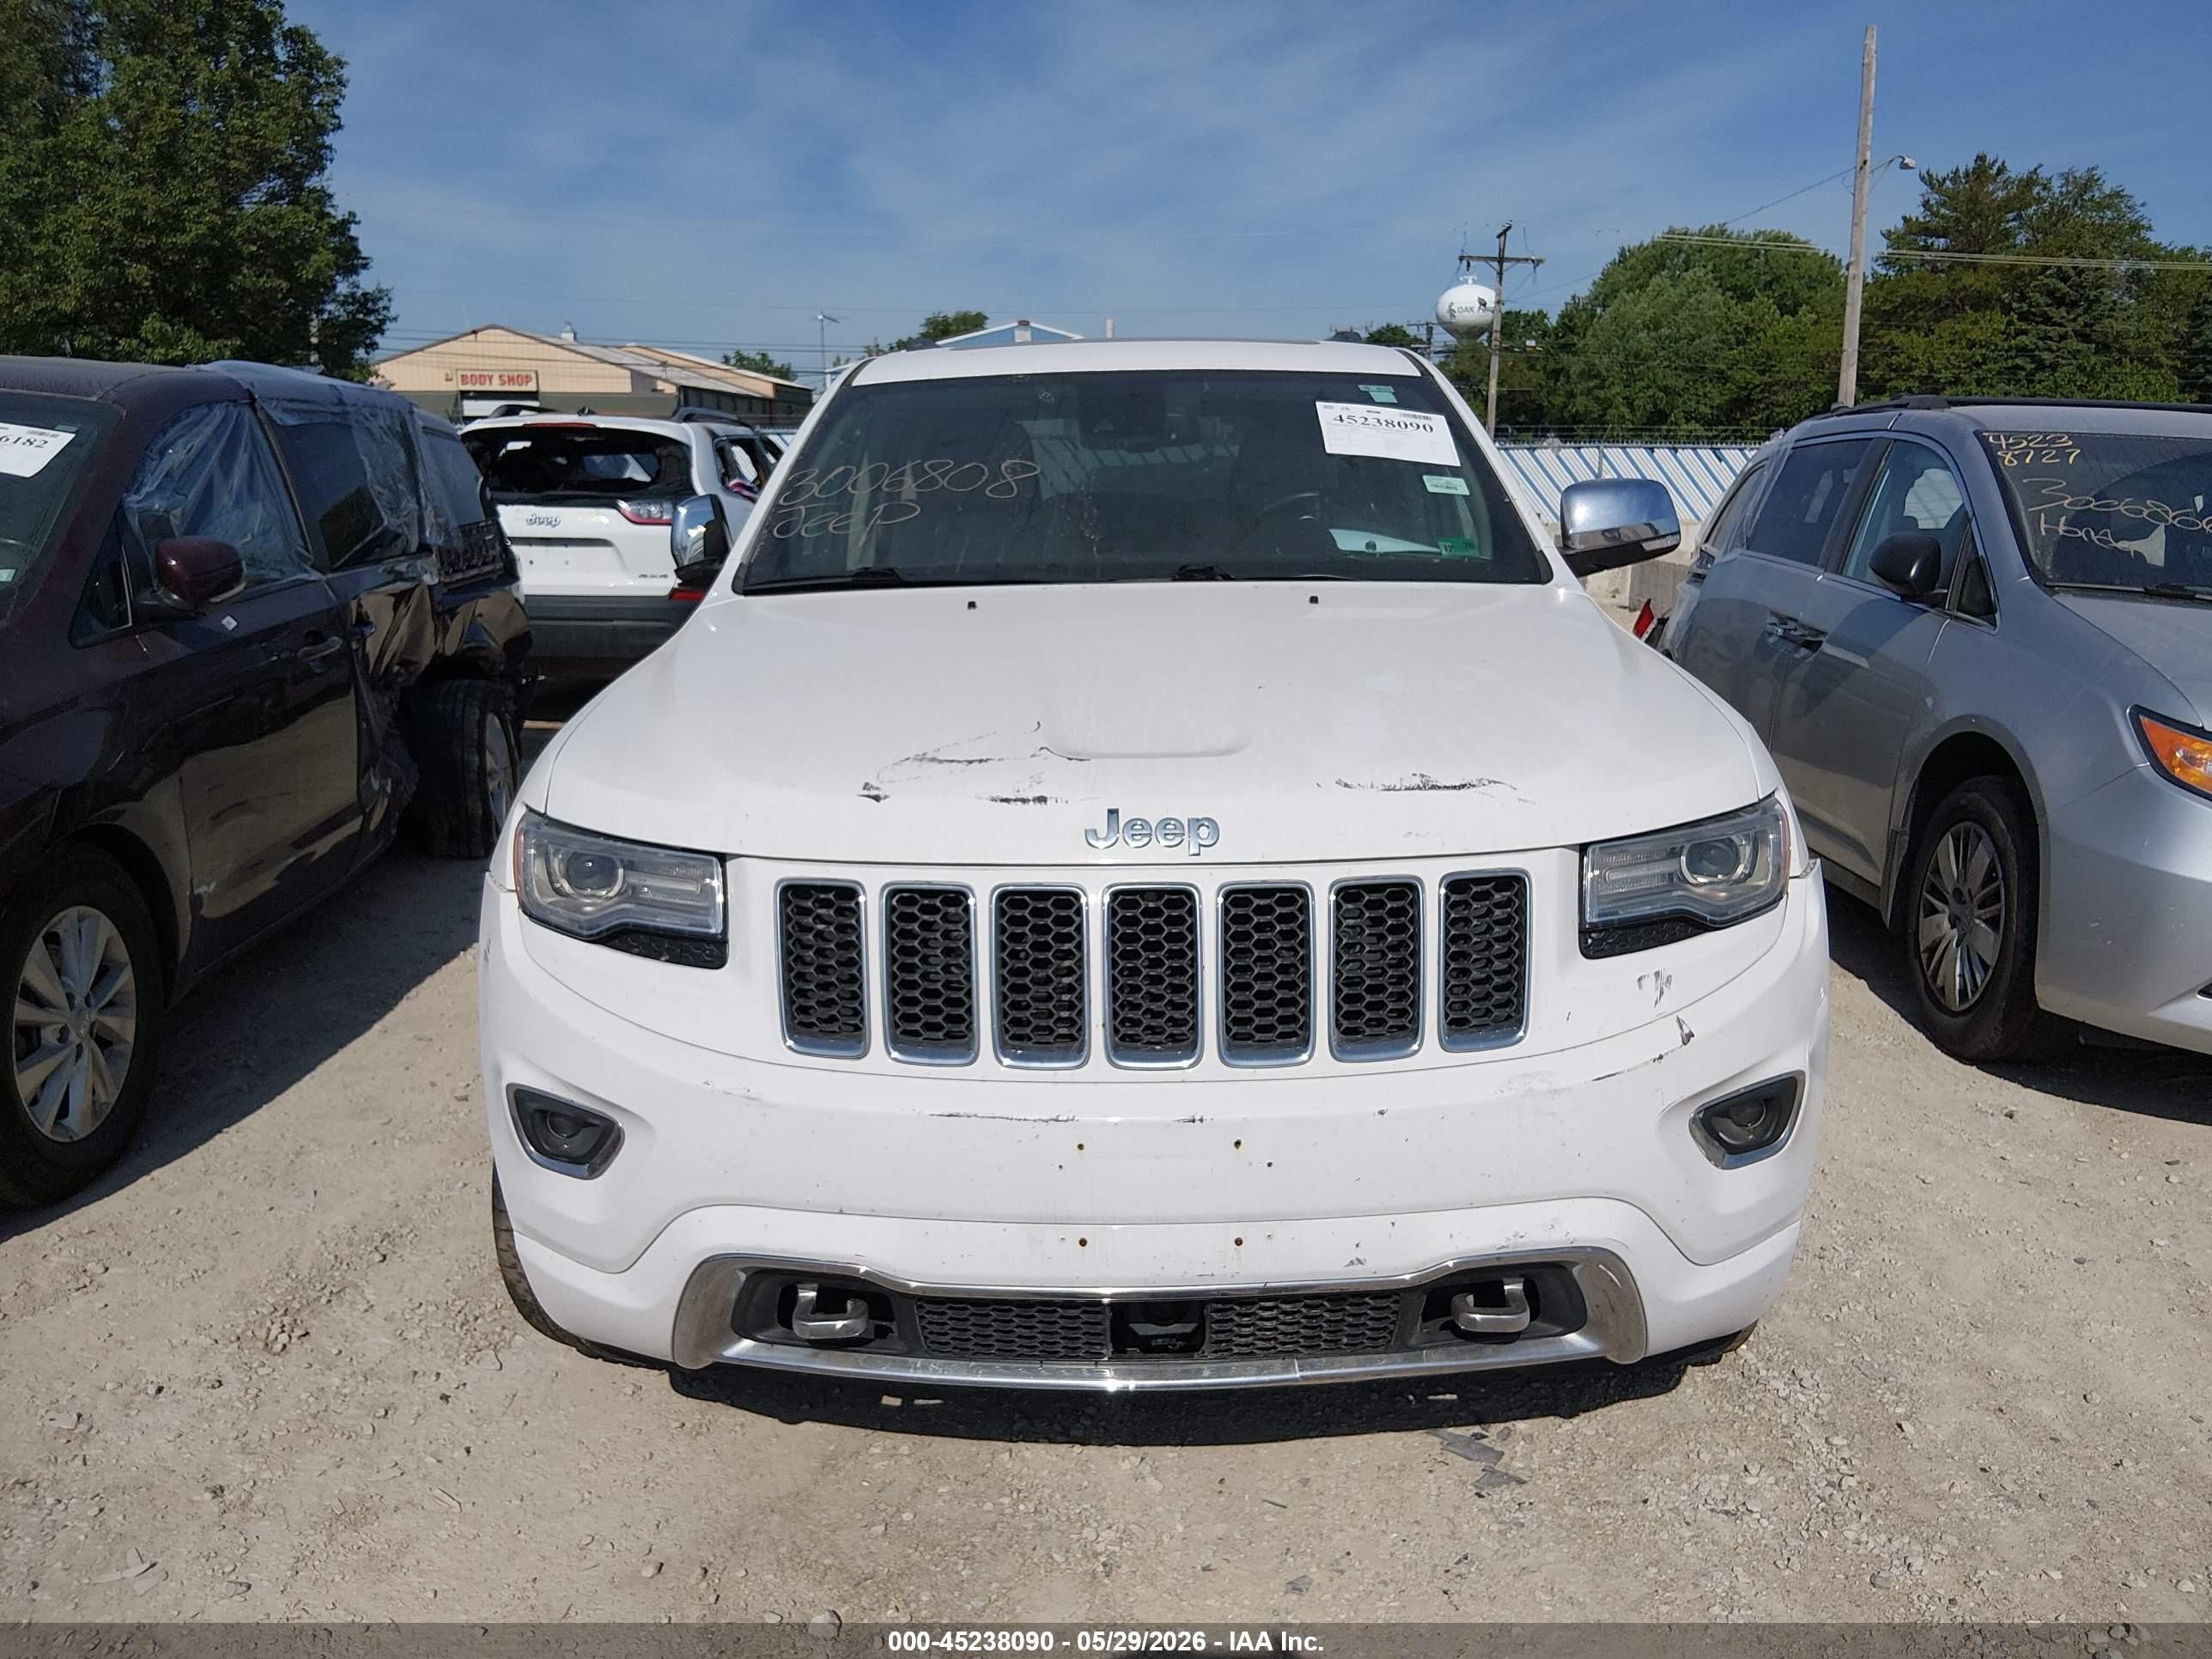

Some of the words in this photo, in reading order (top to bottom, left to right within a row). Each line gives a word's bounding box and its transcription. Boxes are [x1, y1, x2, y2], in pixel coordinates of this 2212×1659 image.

[1457, 306, 1475, 314] OAK
[460, 374, 494, 386] BODY
[498, 374, 532, 386] SHOP
[1333, 414, 1434, 434] 45238090
[1985, 433, 2074, 450] 4523
[1996, 448, 2081, 467] 8727
[778, 459, 1041, 506] 3006808
[526, 514, 561, 528] Jeep
[773, 501, 921, 548] Jeep
[1085, 808, 1220, 856] Jeep
